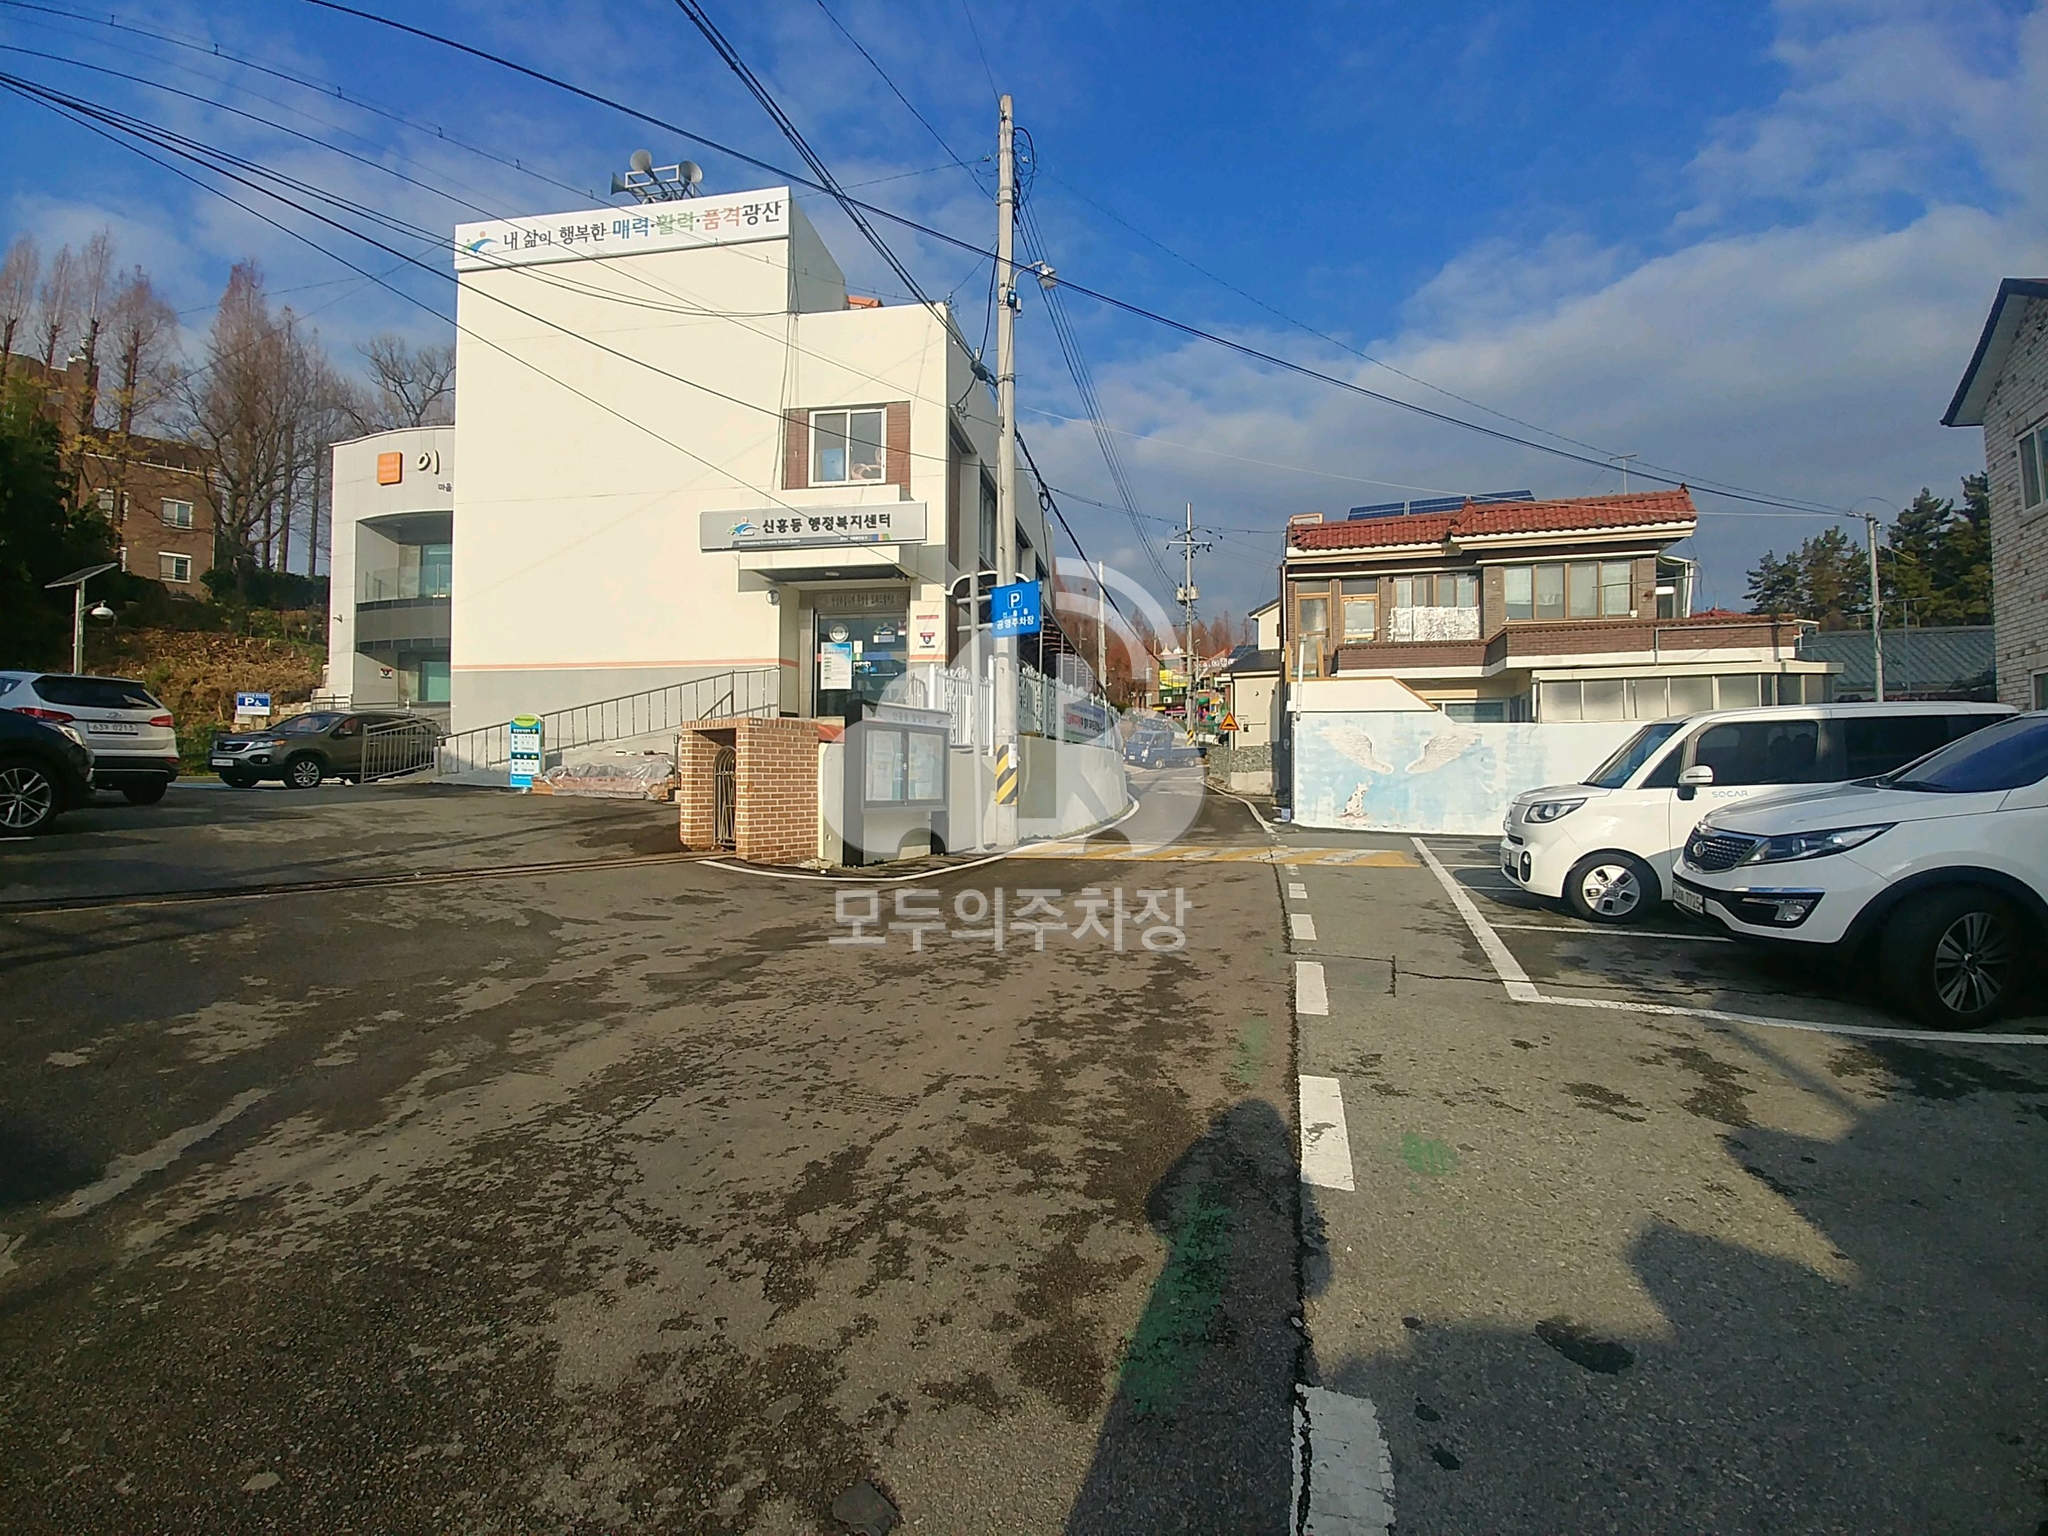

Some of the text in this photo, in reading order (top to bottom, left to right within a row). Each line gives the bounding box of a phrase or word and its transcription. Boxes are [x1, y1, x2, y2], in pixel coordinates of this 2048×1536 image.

[503, 231, 518, 250] 내
[523, 229, 552, 250] 삶이
[559, 221, 607, 245] 행복한
[762, 513, 892, 534] 신흥동 행정복지센터
[1010, 592, 1020, 608] P
[996, 615, 1035, 630] 공영주차장
[244, 697, 255, 706] P
[1711, 789, 1749, 798] SOCAR
